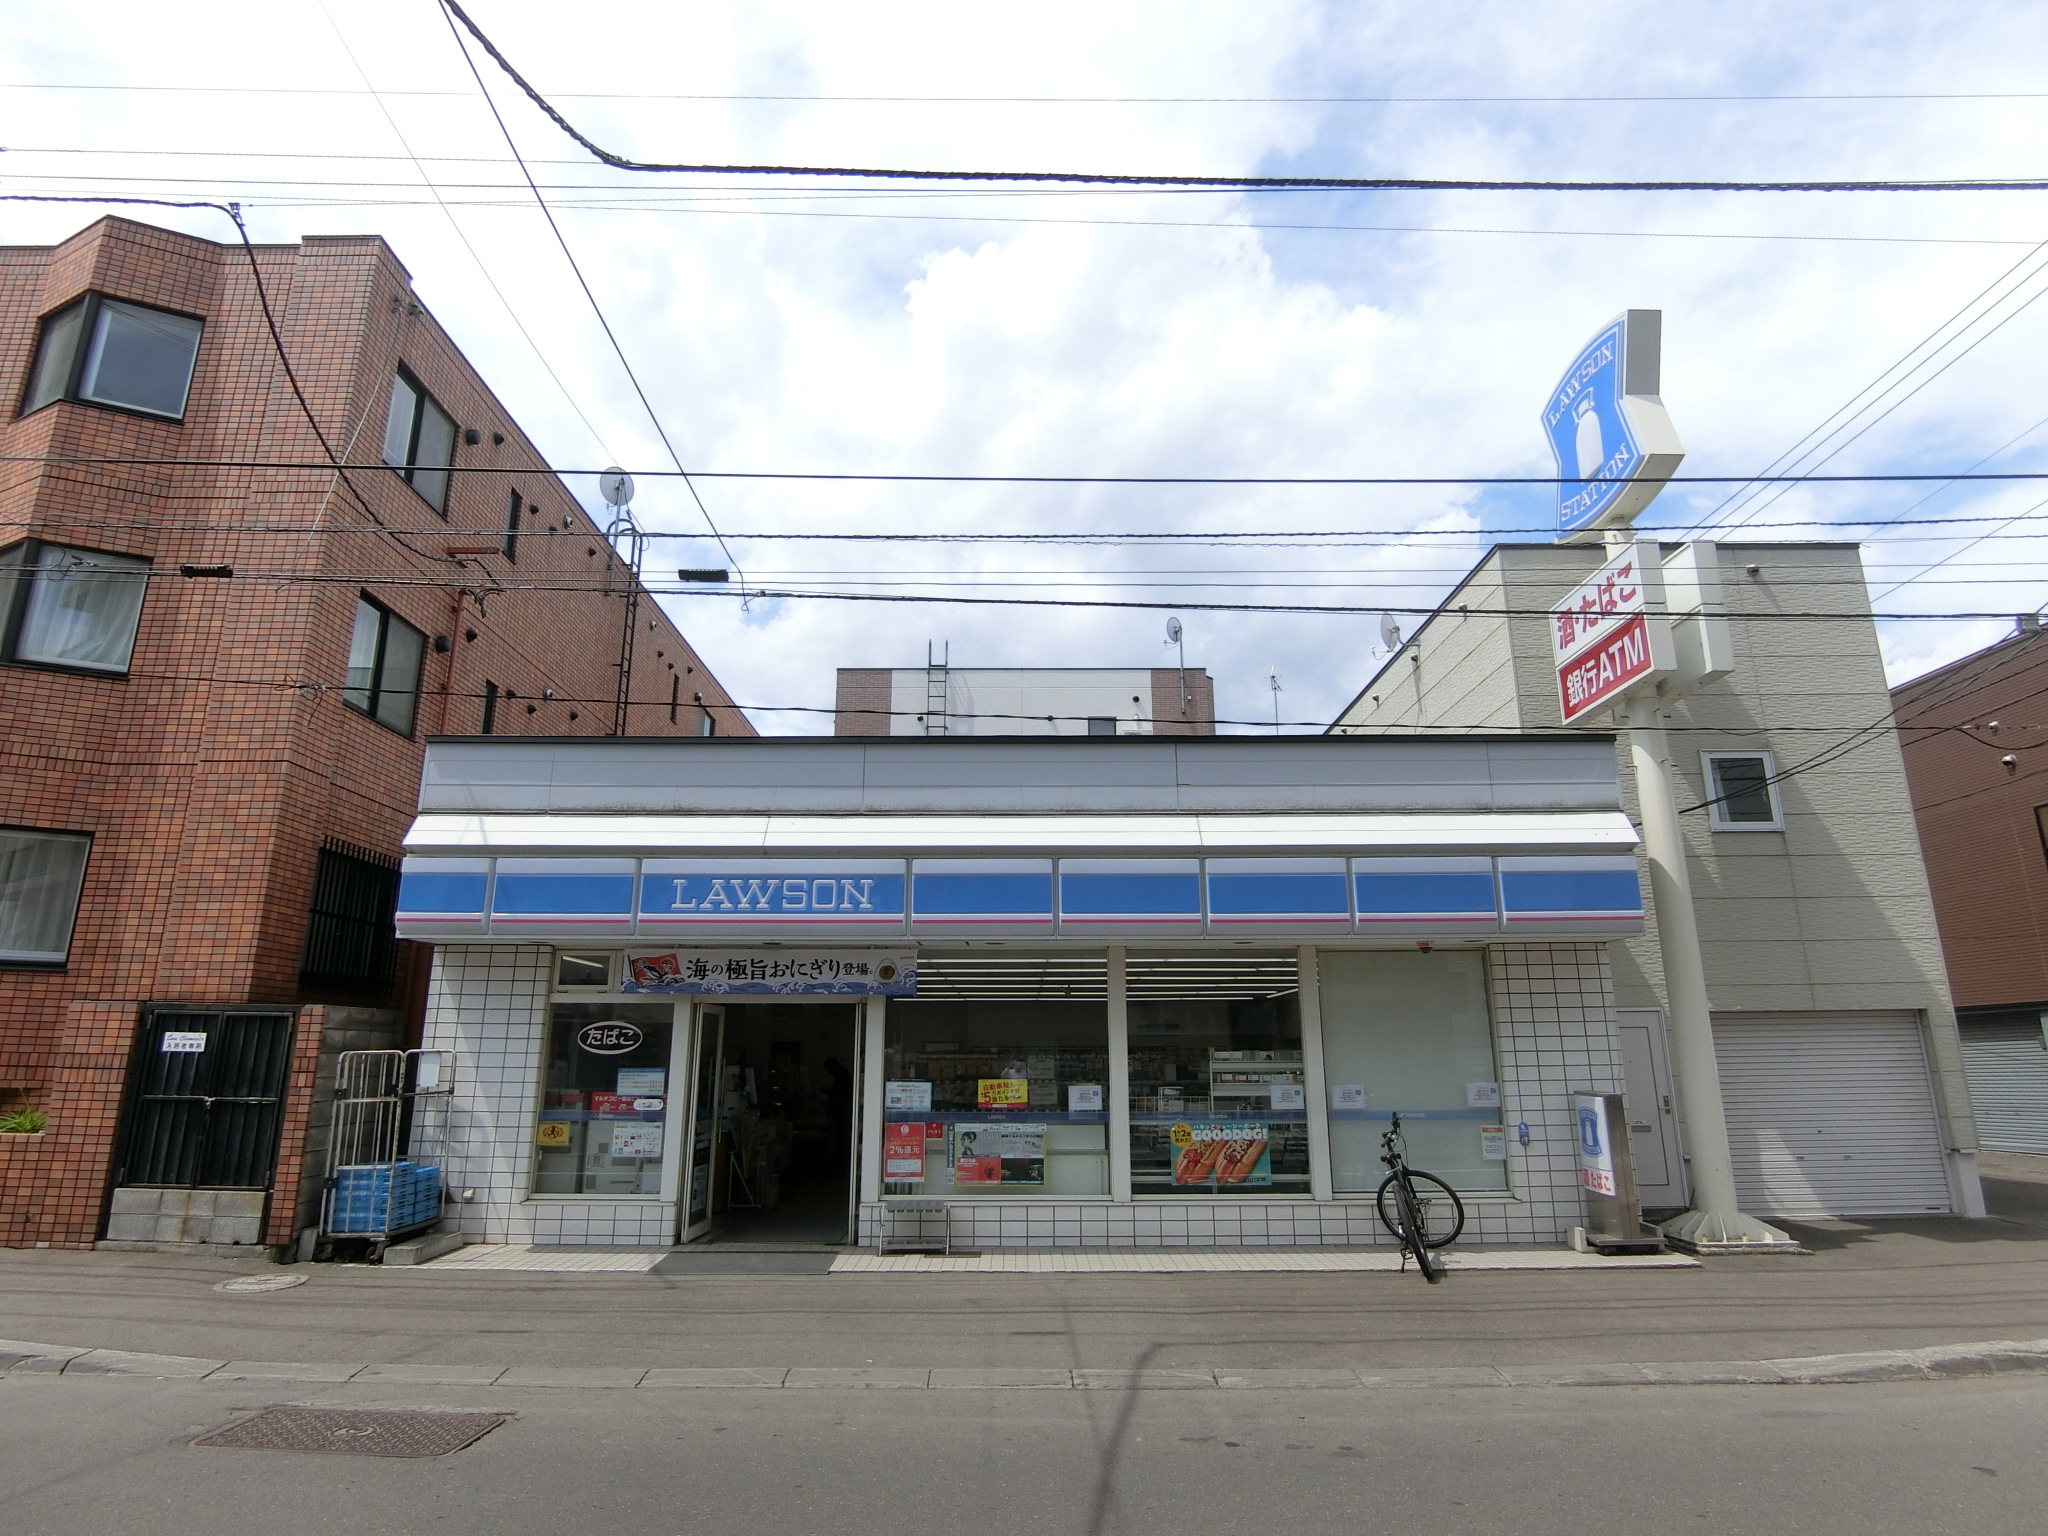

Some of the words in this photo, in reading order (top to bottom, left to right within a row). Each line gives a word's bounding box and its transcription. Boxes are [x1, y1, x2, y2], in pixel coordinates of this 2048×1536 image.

[1548, 339, 1614, 428] LAWSON
[1560, 442, 1631, 523] STATION
[1566, 625, 1646, 709] 銀行ATM
[671, 878, 874, 911] LAWSON
[586, 1028, 634, 1045] たばこ
[889, 1145, 919, 1154] 2%還元
